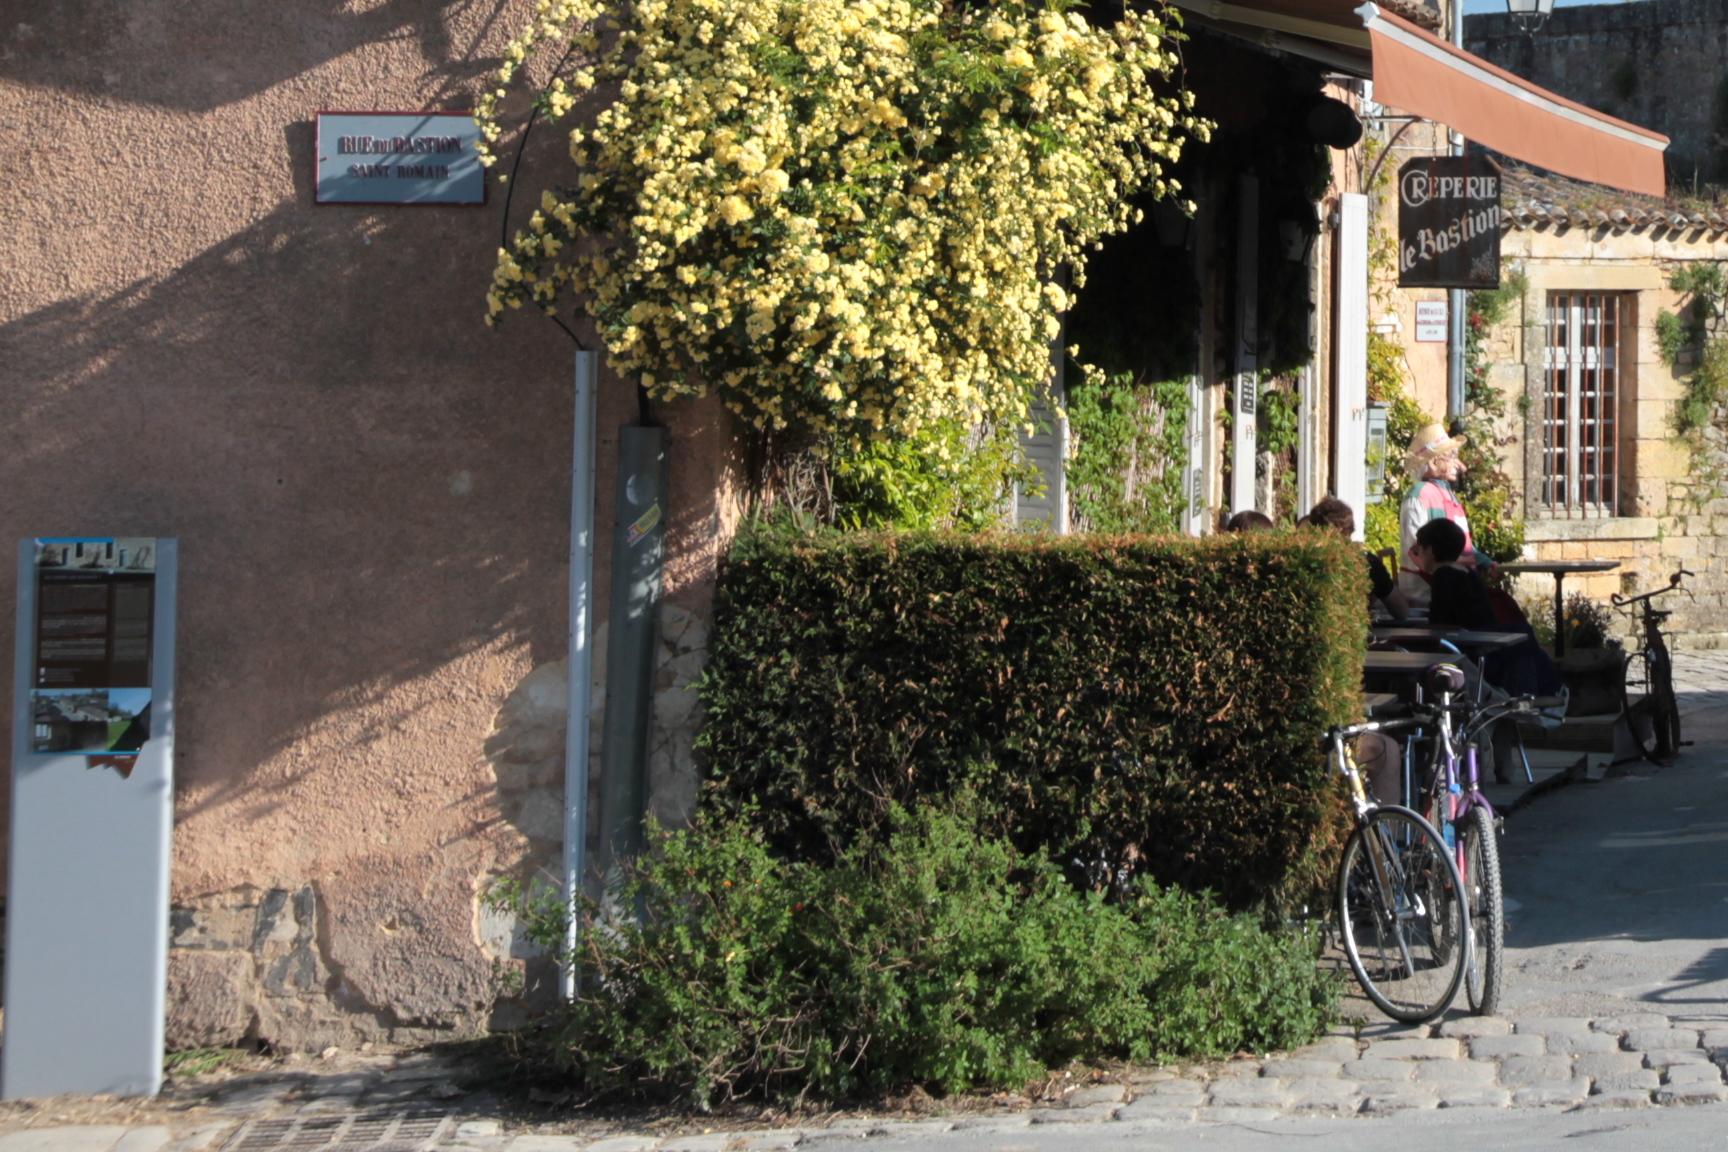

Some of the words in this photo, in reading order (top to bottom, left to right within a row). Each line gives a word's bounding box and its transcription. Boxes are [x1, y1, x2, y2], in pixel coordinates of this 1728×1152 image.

[339, 135, 374, 154] RUE
[395, 135, 463, 154] BASTION
[351, 162, 390, 178] SAINT
[397, 163, 450, 178] ROMAIN
[1400, 238, 1417, 273] le
[1417, 204, 1500, 261] Bastion
